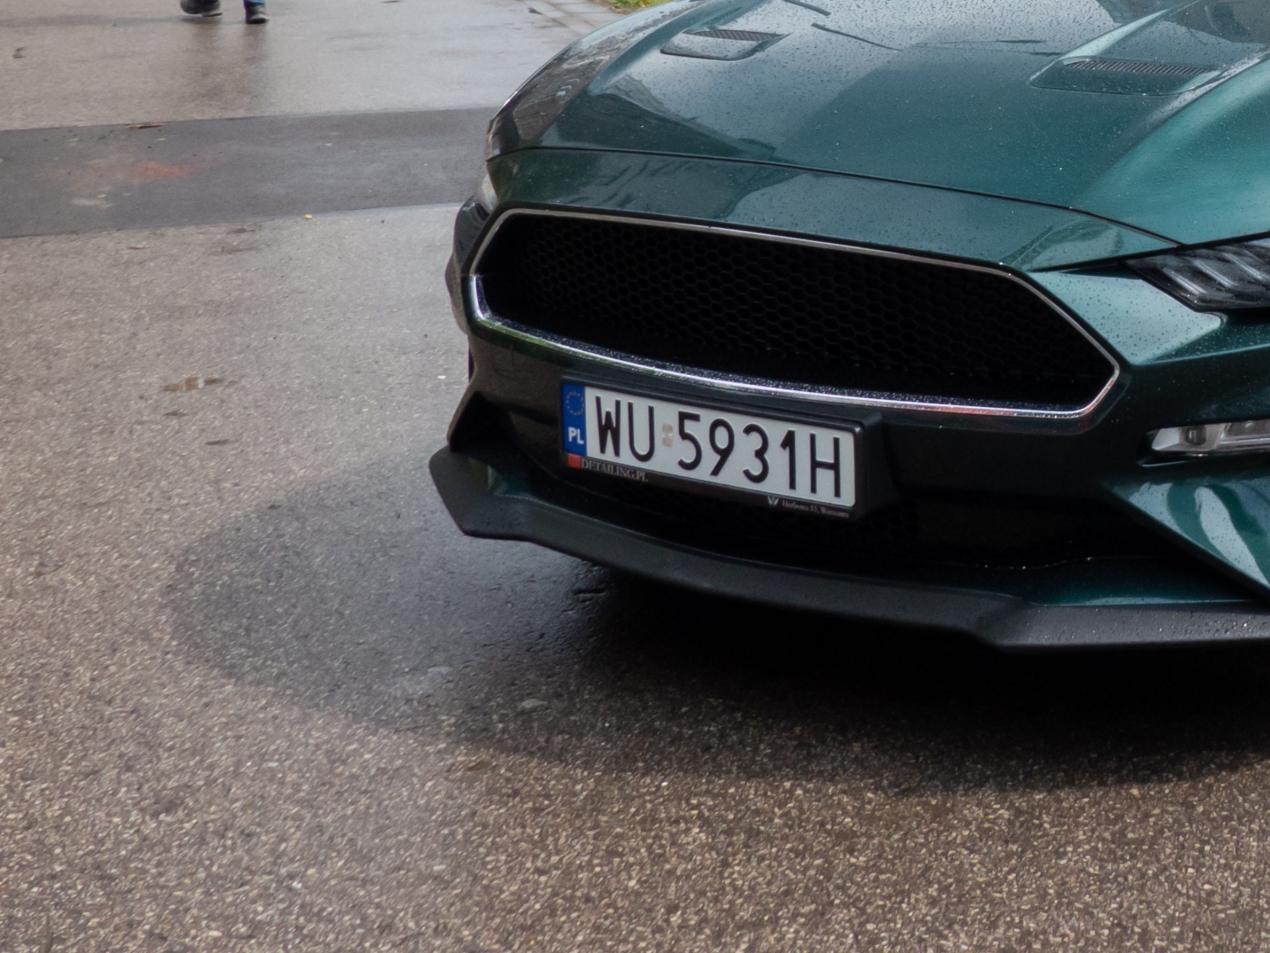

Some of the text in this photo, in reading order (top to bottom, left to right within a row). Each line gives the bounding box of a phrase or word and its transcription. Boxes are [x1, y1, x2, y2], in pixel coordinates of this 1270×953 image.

[568, 426, 584, 445] PL
[595, 396, 841, 498] WU 5931H
[581, 458, 649, 482] DETAILING.PL
